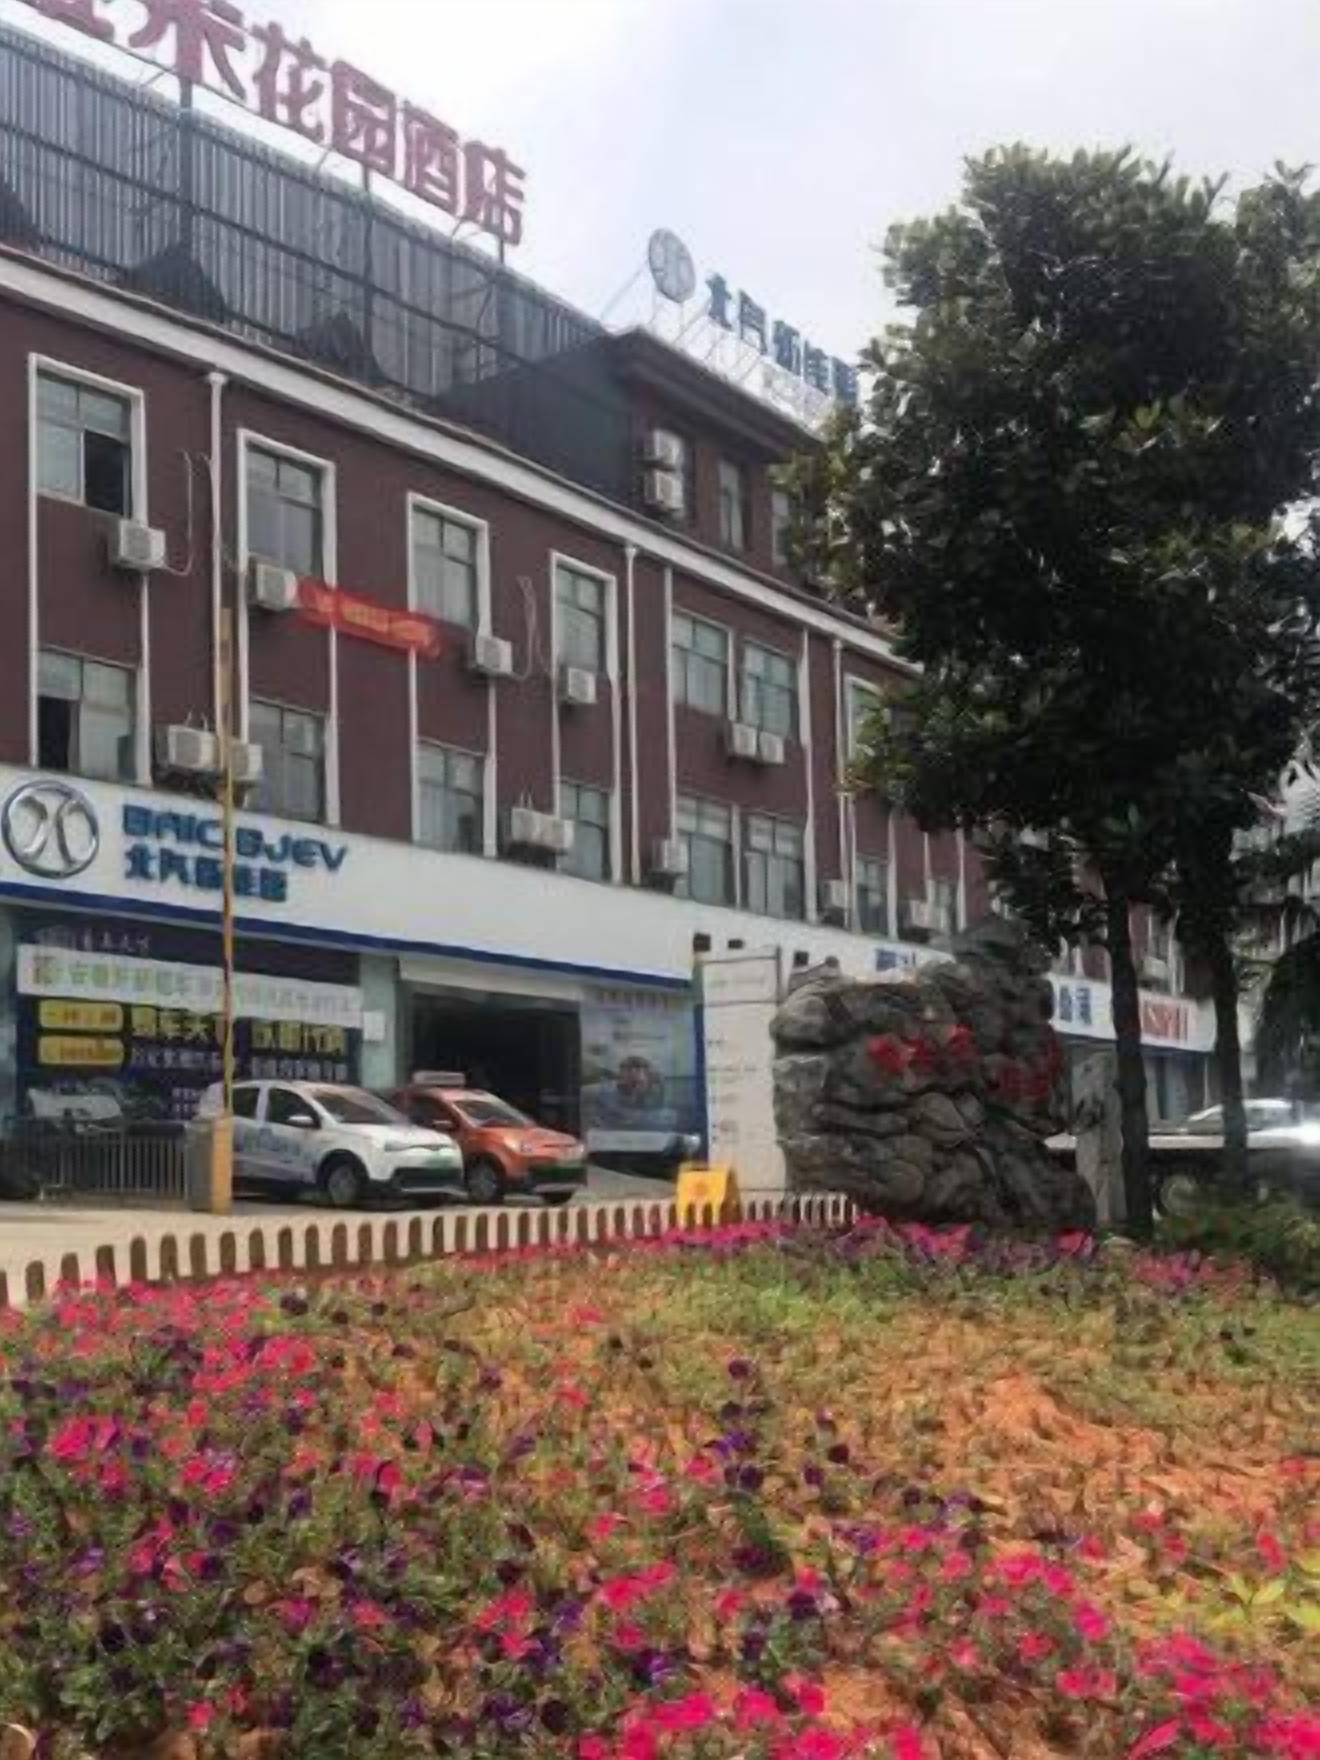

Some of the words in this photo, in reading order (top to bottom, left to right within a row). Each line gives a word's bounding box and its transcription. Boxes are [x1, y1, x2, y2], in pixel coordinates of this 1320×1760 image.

[32, 0, 526, 247] 朵花园酒店
